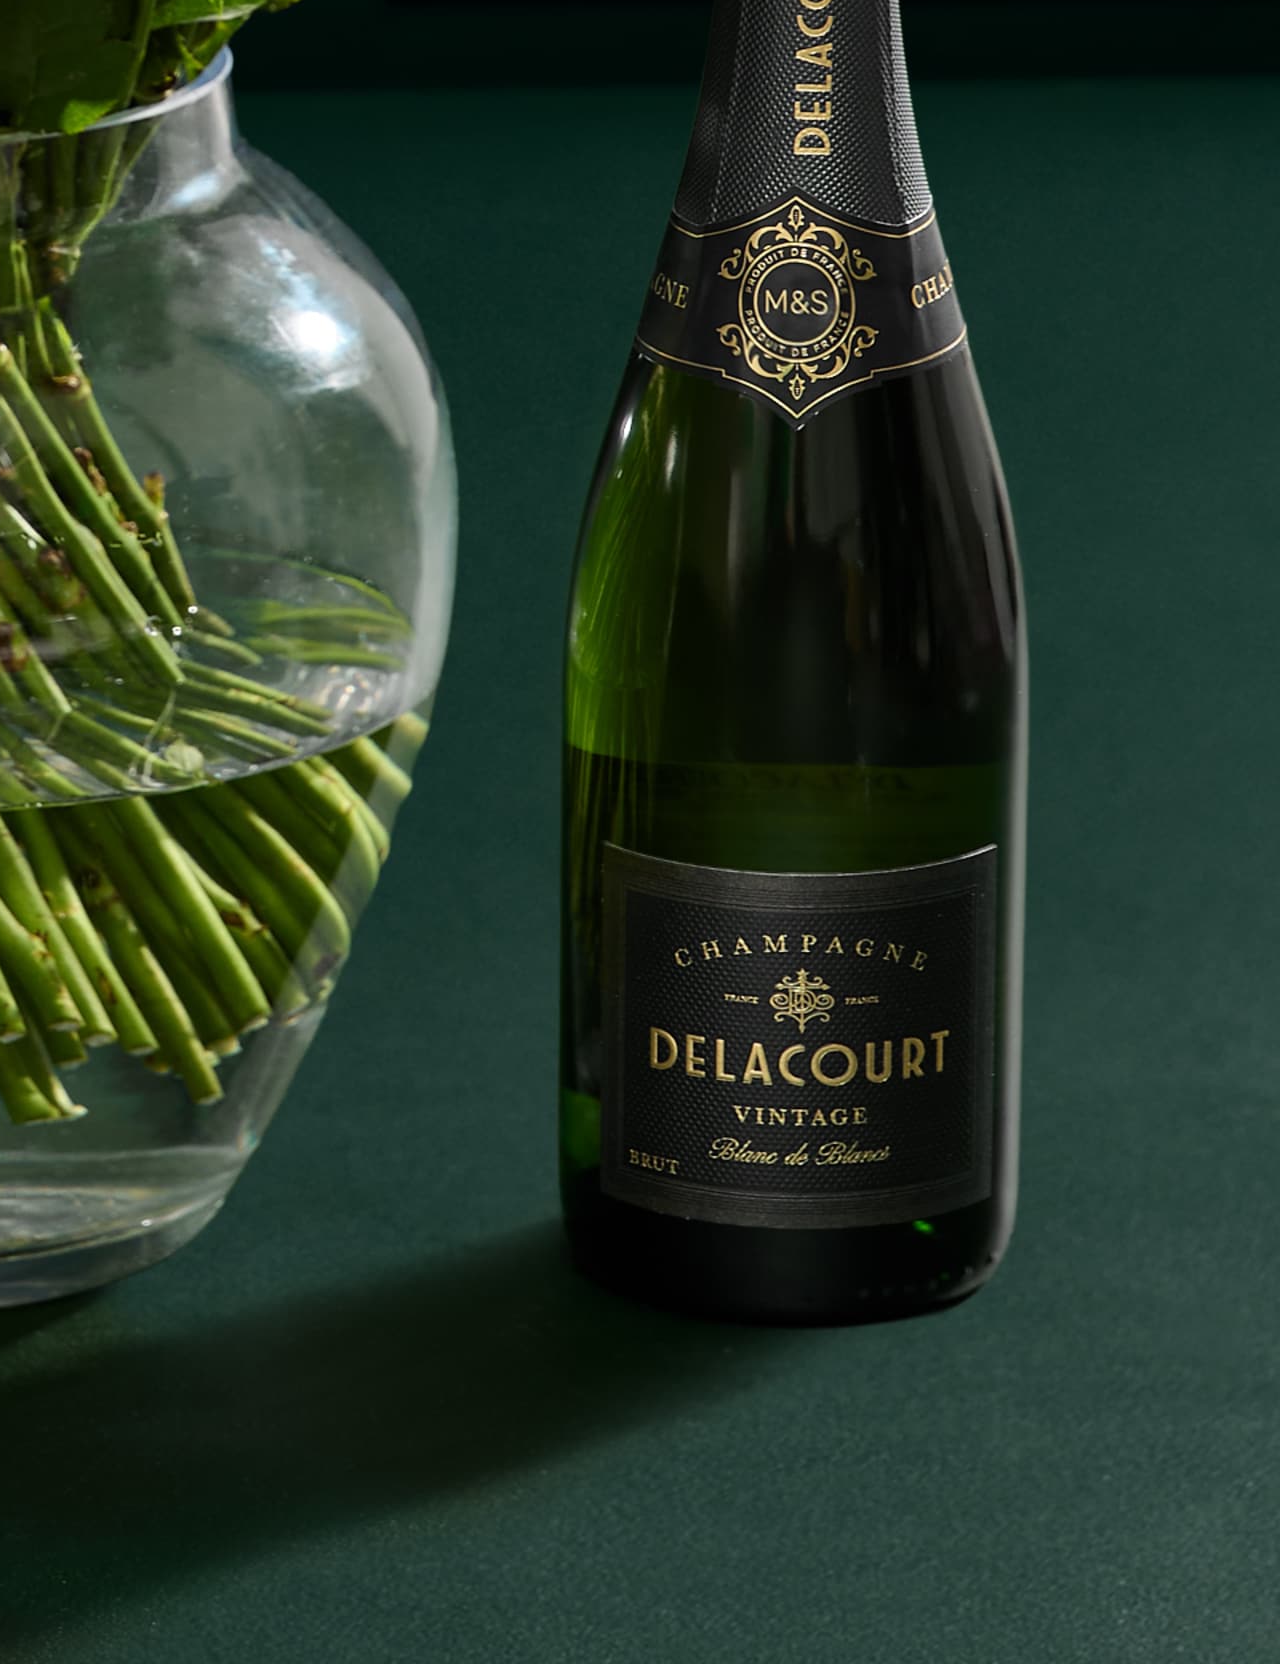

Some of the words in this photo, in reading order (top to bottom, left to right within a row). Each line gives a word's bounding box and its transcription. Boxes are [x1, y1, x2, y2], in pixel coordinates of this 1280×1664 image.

[745, 249, 785, 294] PRODUIT
[790, 247, 808, 258] DE
[812, 251, 848, 295] FRANCE
[764, 289, 829, 316] M&S
[744, 309, 786, 354] PRODUIT
[790, 347, 809, 357] DE
[813, 311, 849, 353] FRANCE
[675, 933, 929, 972] CHAMPAGNE
[649, 1026, 951, 1087] DELACOURT
[732, 1104, 869, 1127] VINTAGE
[628, 1148, 681, 1175] BRUT
[708, 1136, 779, 1167] Blanc
[784, 1140, 810, 1167] de
[814, 1140, 891, 1167] Blancs
